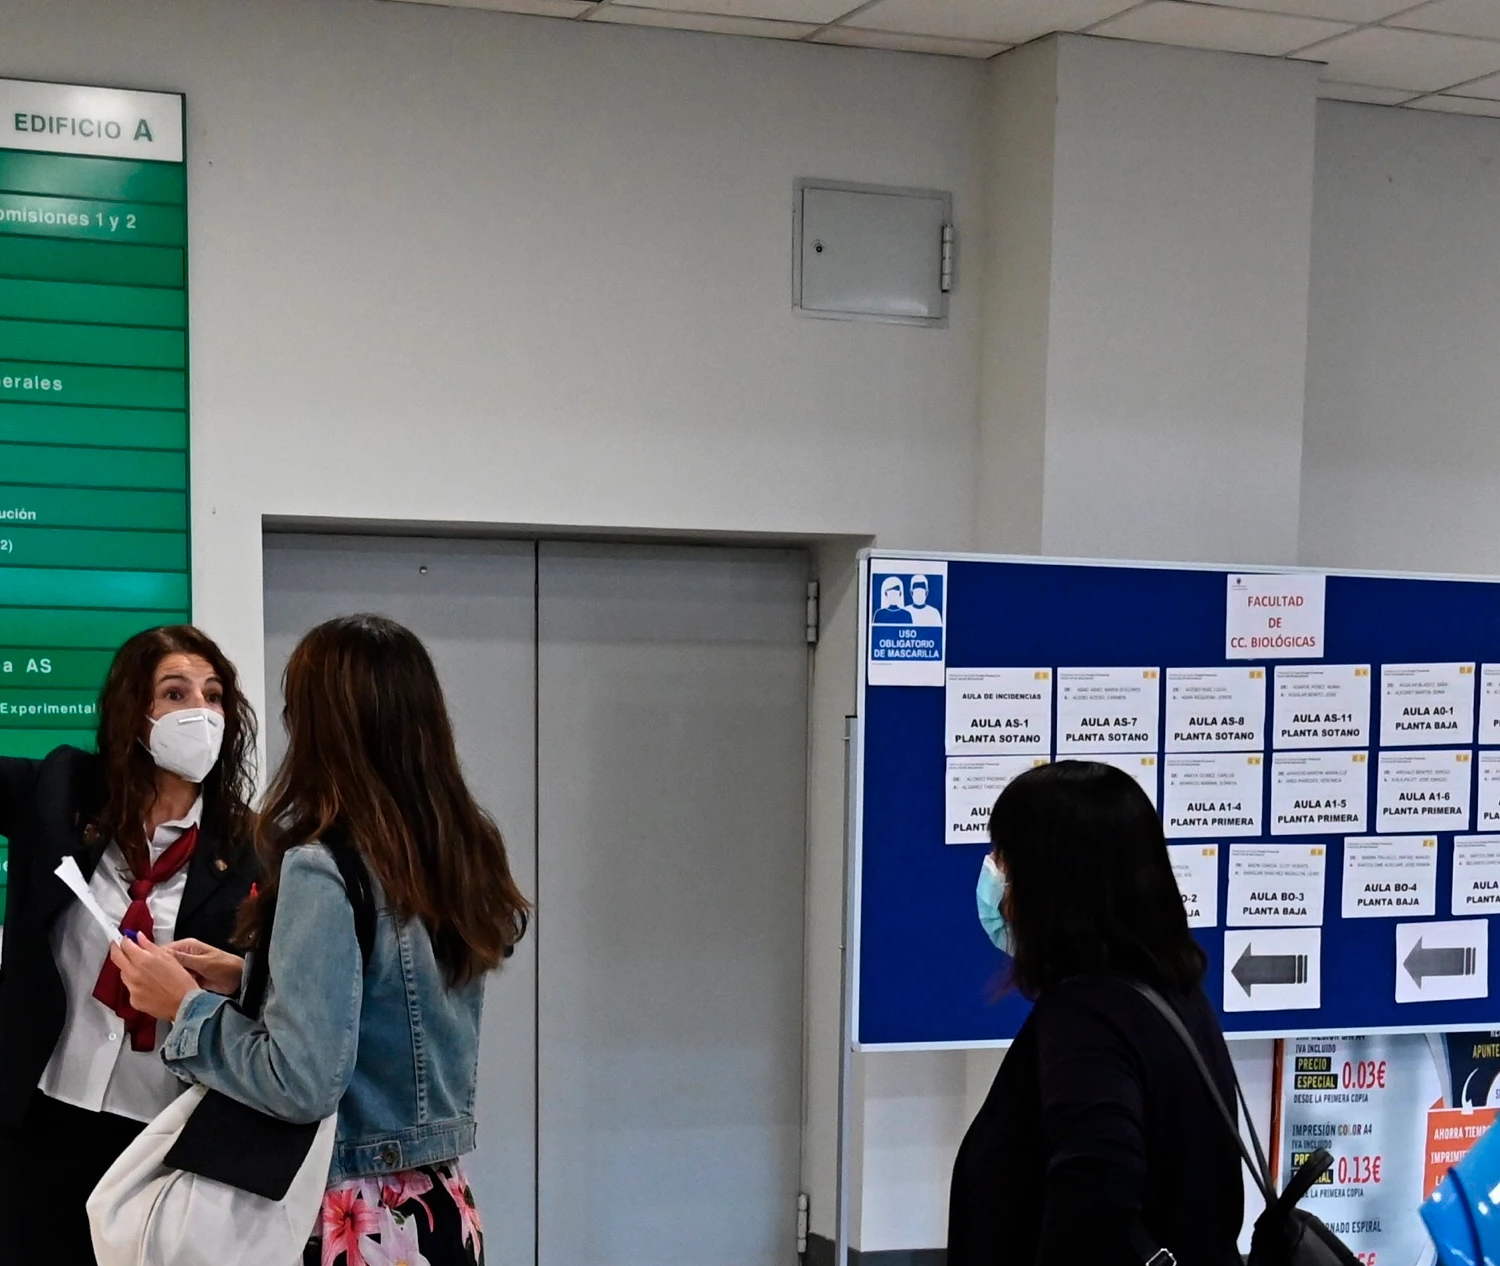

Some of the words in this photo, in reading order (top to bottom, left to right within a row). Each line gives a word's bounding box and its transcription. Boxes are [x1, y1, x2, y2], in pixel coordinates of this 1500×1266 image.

[15, 113, 121, 139] EDIFICIO
[134, 119, 152, 141] A
[1248, 596, 1303, 606] FACULTAD
[1269, 618, 1281, 628] DE
[898, 629, 917, 638] USO
[879, 639, 935, 649] OBLIGATORIO
[1230, 636, 1247, 648] CC.
[1252, 634, 1315, 648] BIOLÓGICAS
[874, 649, 885, 659] DE
[888, 649, 939, 658] MASCARILLA
[1403, 707, 1430, 716] AULA
[1433, 707, 1454, 715] A0-1
[971, 719, 1001, 727] AULA
[1005, 718, 1028, 727] AS-1
[1396, 722, 1431, 730] PLANTA
[1434, 721, 1457, 730] BAJA
[955, 735, 996, 743] PLANTA
[1000, 734, 1040, 743] SOTANO
[1399, 792, 1425, 801] AULA
[1429, 792, 1450, 801] A1-6
[1383, 807, 1418, 815] PLANTA
[1421, 806, 1462, 815] PRIMERA
[1298, 1059, 1327, 1070] PRECIO
[1297, 1076, 1335, 1088] ESPECIAL
[1343, 1061, 1385, 1088] 0.03€
[1294, 1094, 1313, 1104] DESDE
[1315, 1095, 1322, 1103] LA
[1324, 1094, 1349, 1102] PRIMERA
[1351, 1094, 1368, 1102] COPIA
[1338, 1156, 1380, 1184] 0.13€
